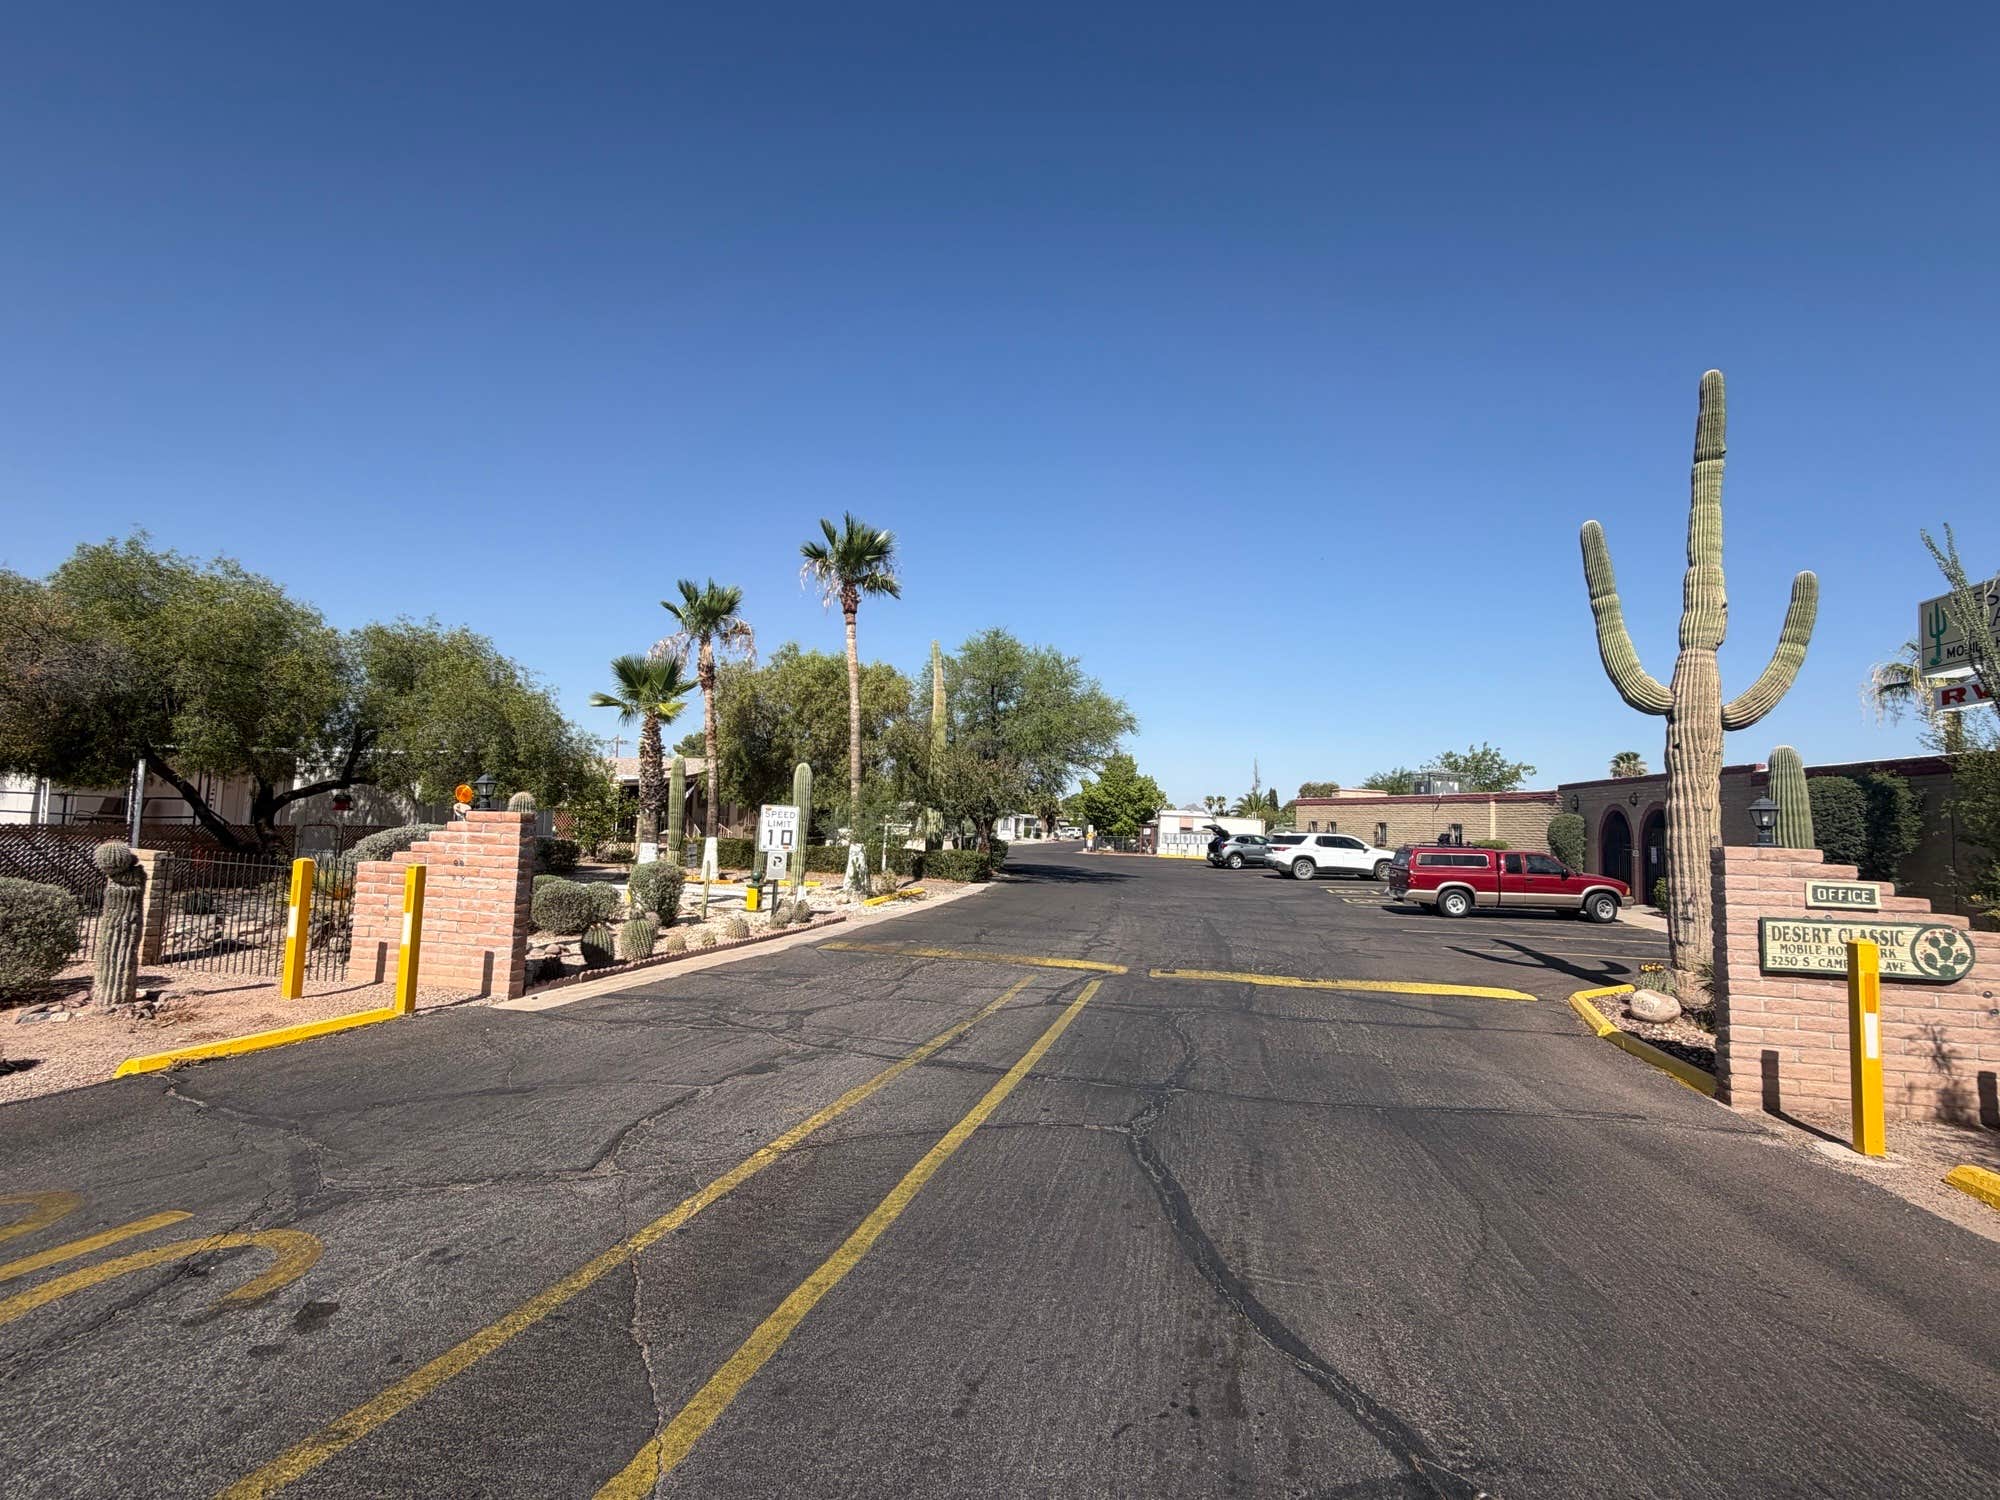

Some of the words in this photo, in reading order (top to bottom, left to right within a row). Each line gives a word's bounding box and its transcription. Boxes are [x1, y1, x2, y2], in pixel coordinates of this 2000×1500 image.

[765, 810, 796, 818] SPEED
[768, 829, 793, 846] 10
[1817, 888, 1871, 903] OFFICE
[1771, 925, 1832, 944] DESERT
[1780, 943, 1822, 955] MOBILE
[1771, 955, 1798, 966] 5250
[1802, 956, 1810, 967] S
[1885, 961, 1906, 971] AVE
